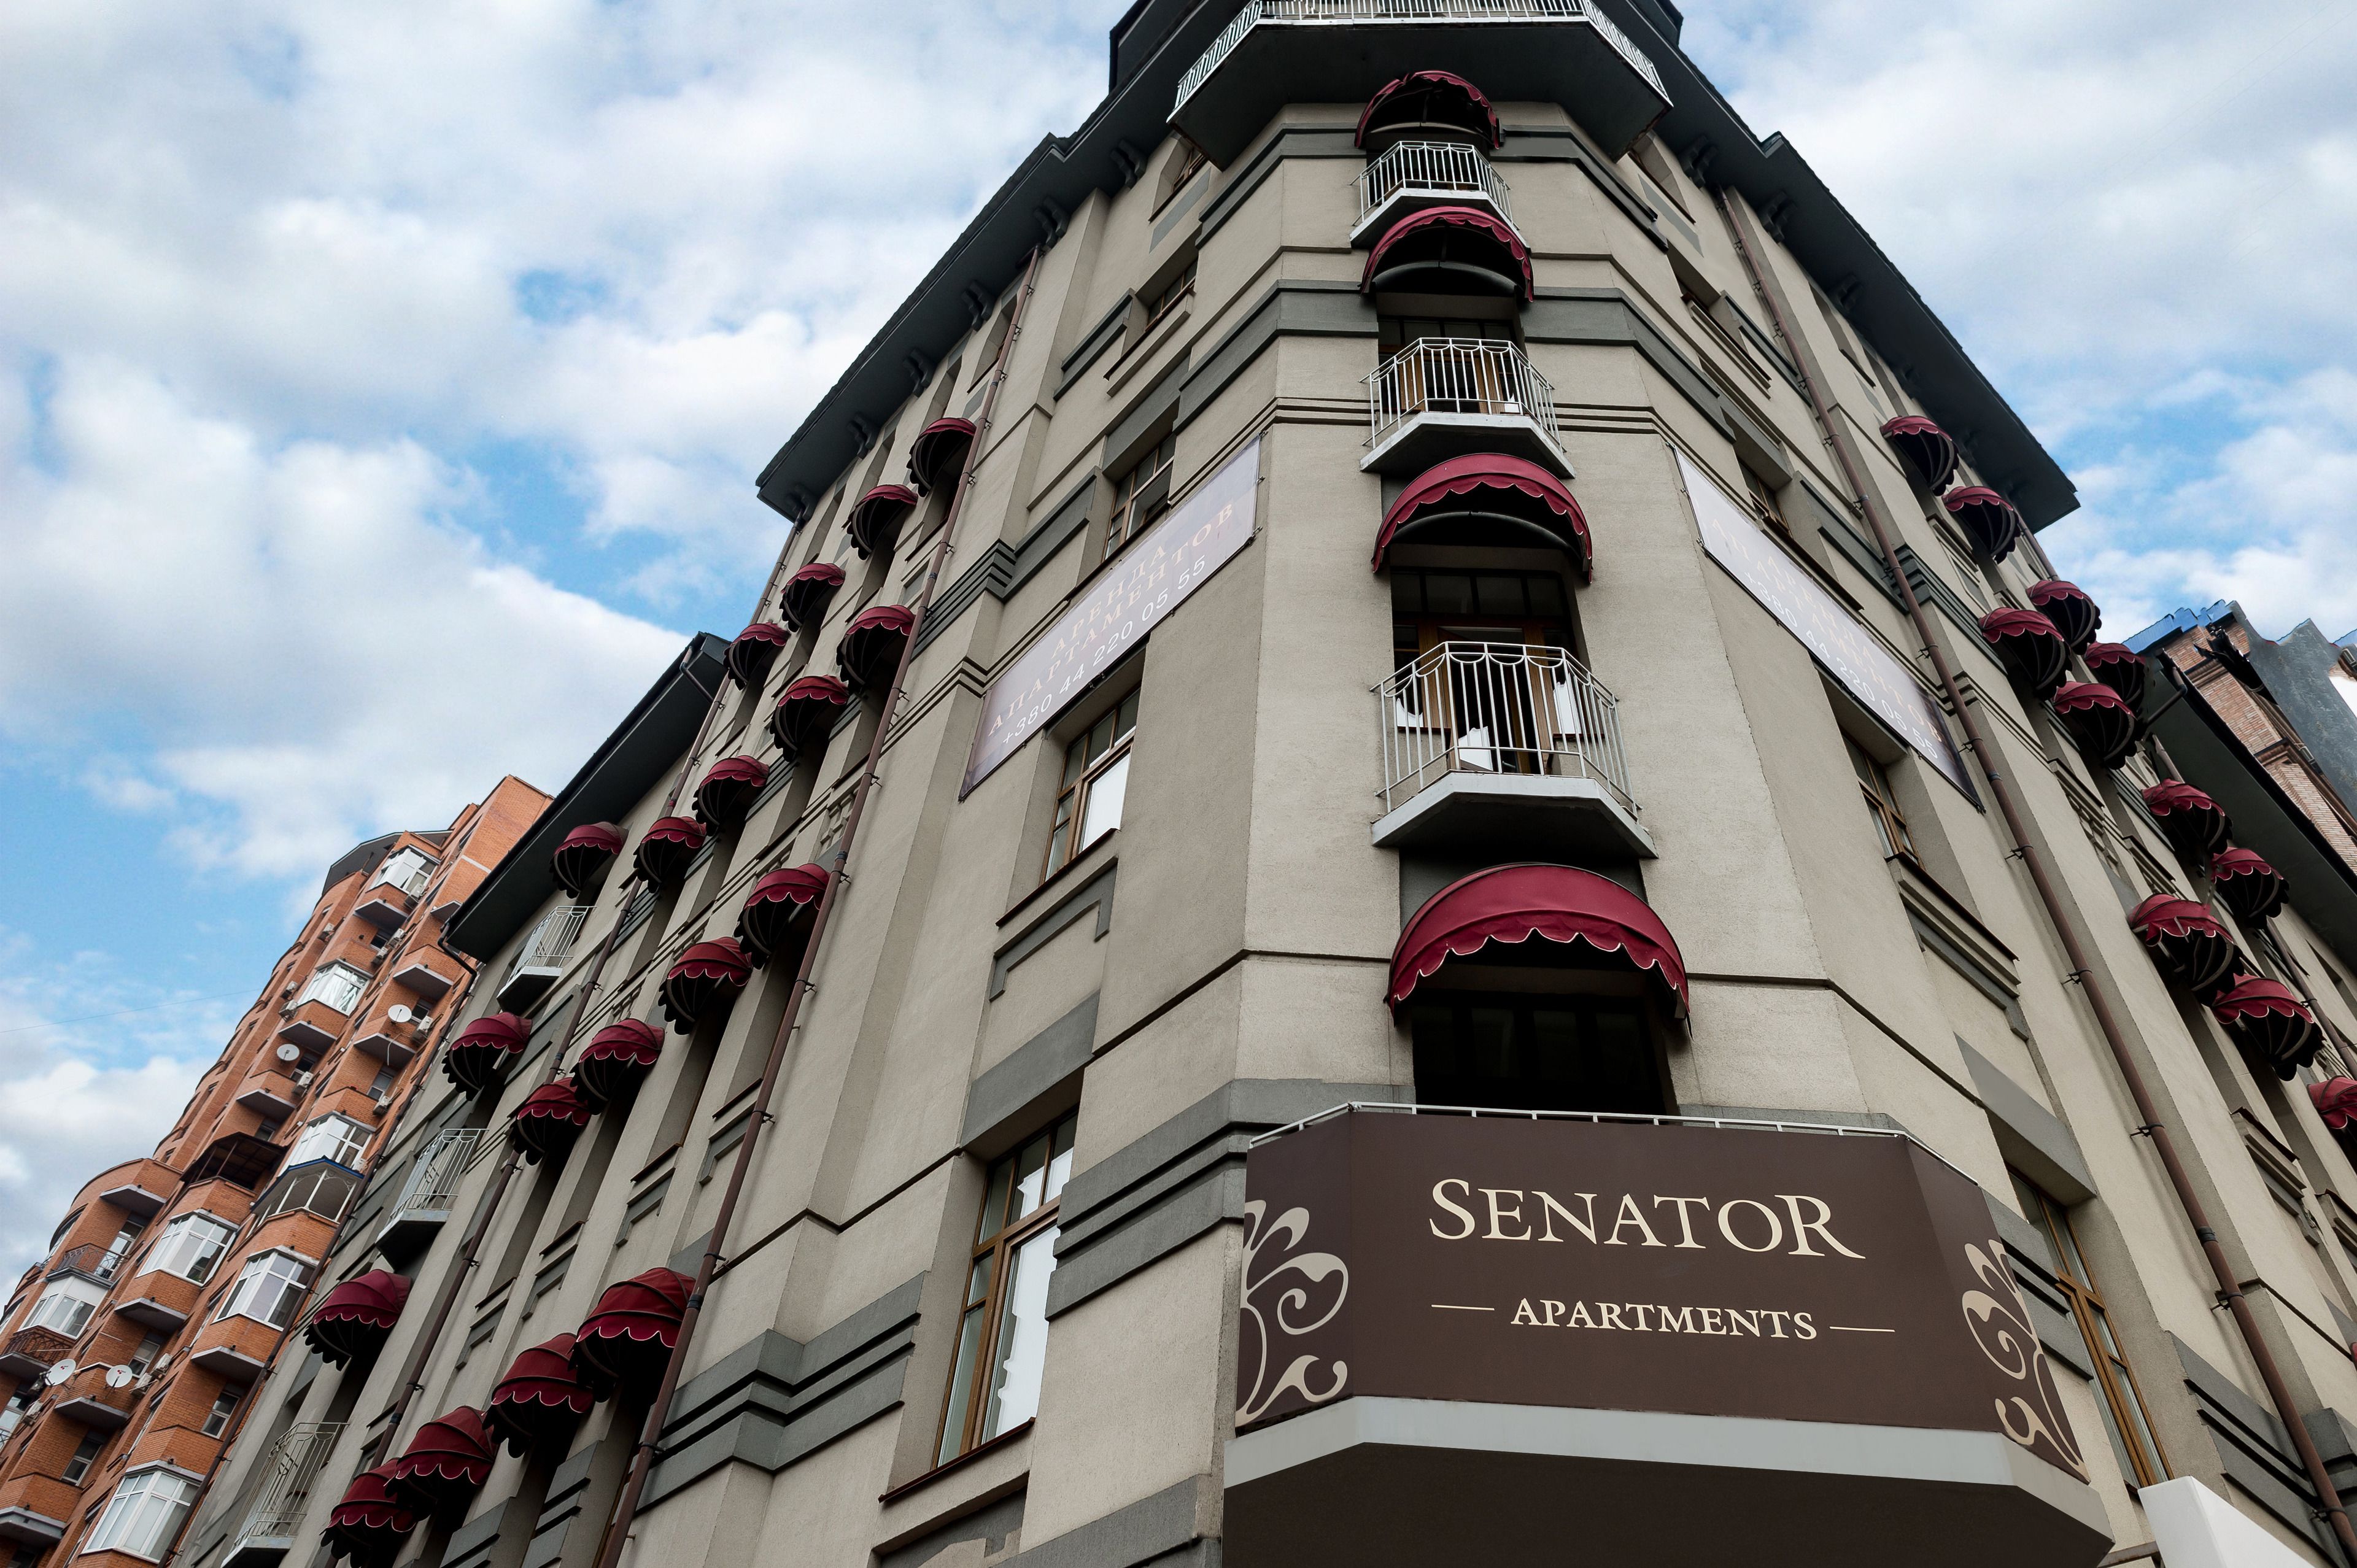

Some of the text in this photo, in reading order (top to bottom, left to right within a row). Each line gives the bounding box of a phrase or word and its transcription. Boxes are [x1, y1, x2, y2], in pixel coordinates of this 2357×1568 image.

[988, 503, 1233, 736] АПАРТАМЕНТОВ
[1002, 554, 1206, 744] +380 44 220 05 55
[1051, 544, 1167, 657] АРЕНДА
[1744, 572, 1938, 759] +380 44 220 05 55
[1430, 1178, 1865, 1259] SENATOR
[1511, 1298, 1816, 1340] APARTMENTS
